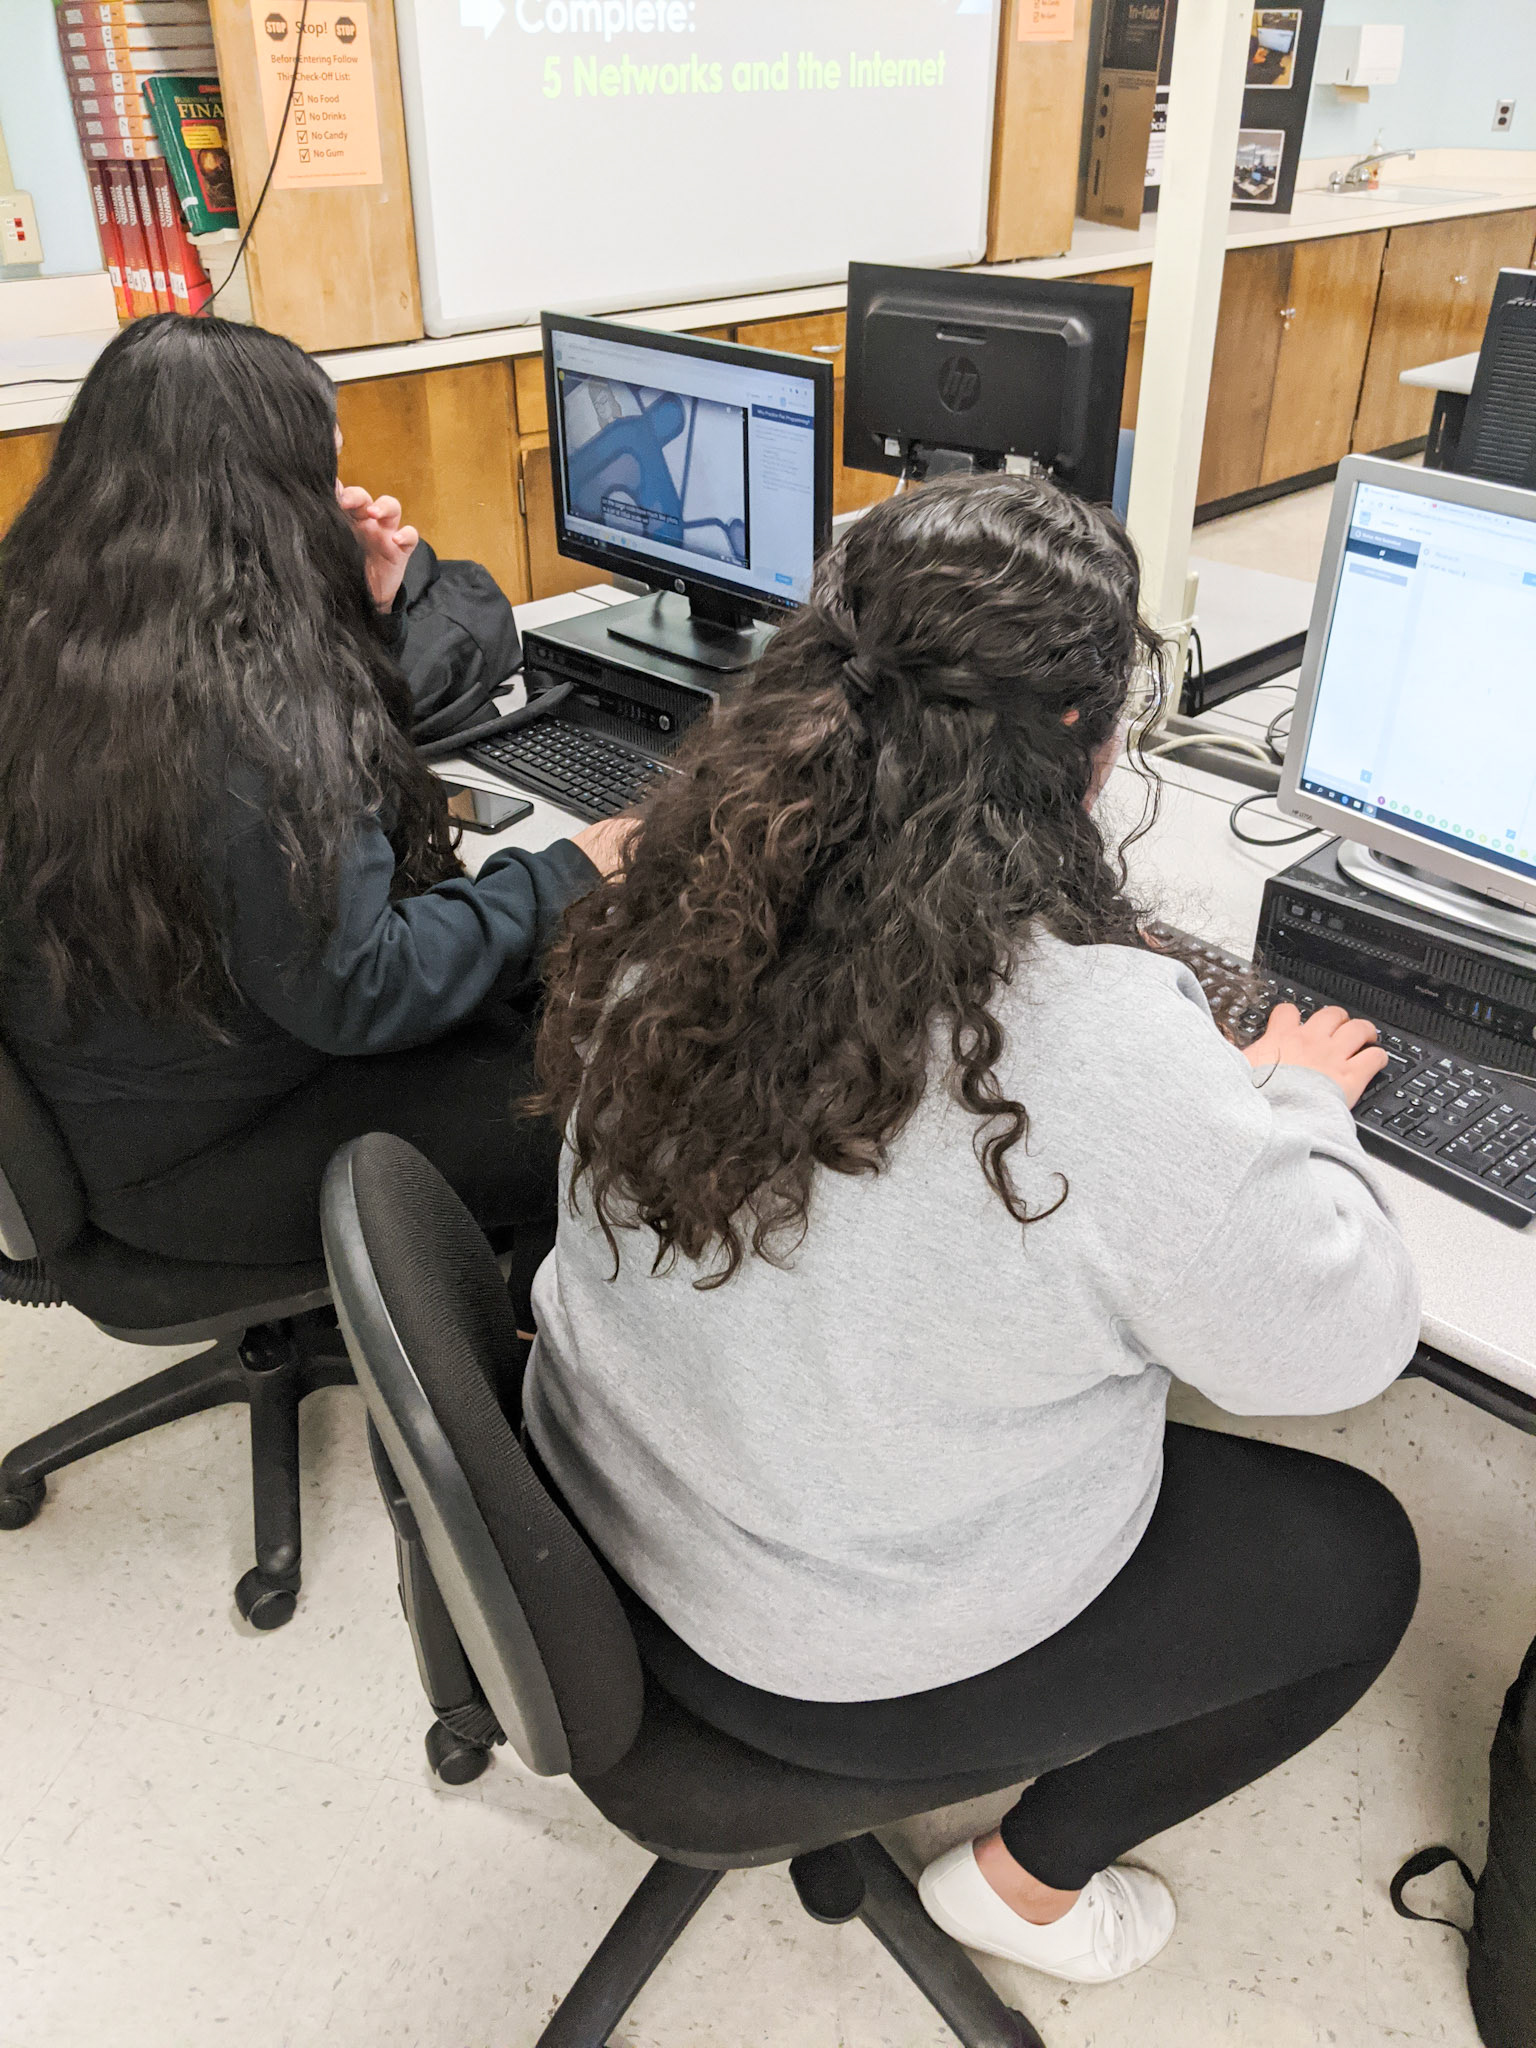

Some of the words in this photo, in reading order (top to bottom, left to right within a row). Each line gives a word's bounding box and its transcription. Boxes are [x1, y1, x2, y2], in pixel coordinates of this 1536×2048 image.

[265, 21, 287, 34] STOP
[515, 0, 696, 43] Complete:
[295, 21, 328, 38] Stop!
[336, 24, 356, 37] STOP
[298, 55, 332, 66] Entering
[333, 54, 358, 63] Follow
[334, 72, 351, 81] List:
[542, 55, 562, 98] 5
[573, 53, 723, 97] Networks
[731, 51, 789, 92] and
[797, 51, 841, 90] the
[849, 50, 946, 88] Internet
[307, 95, 319, 103] No
[320, 94, 340, 103] Food
[176, 103, 225, 118] FINA
[309, 113, 321, 121] No
[322, 112, 347, 121] Drinks
[311, 131, 322, 140] No
[323, 131, 348, 141] Candy
[313, 150, 325, 158] No
[326, 149, 344, 158] Gum
